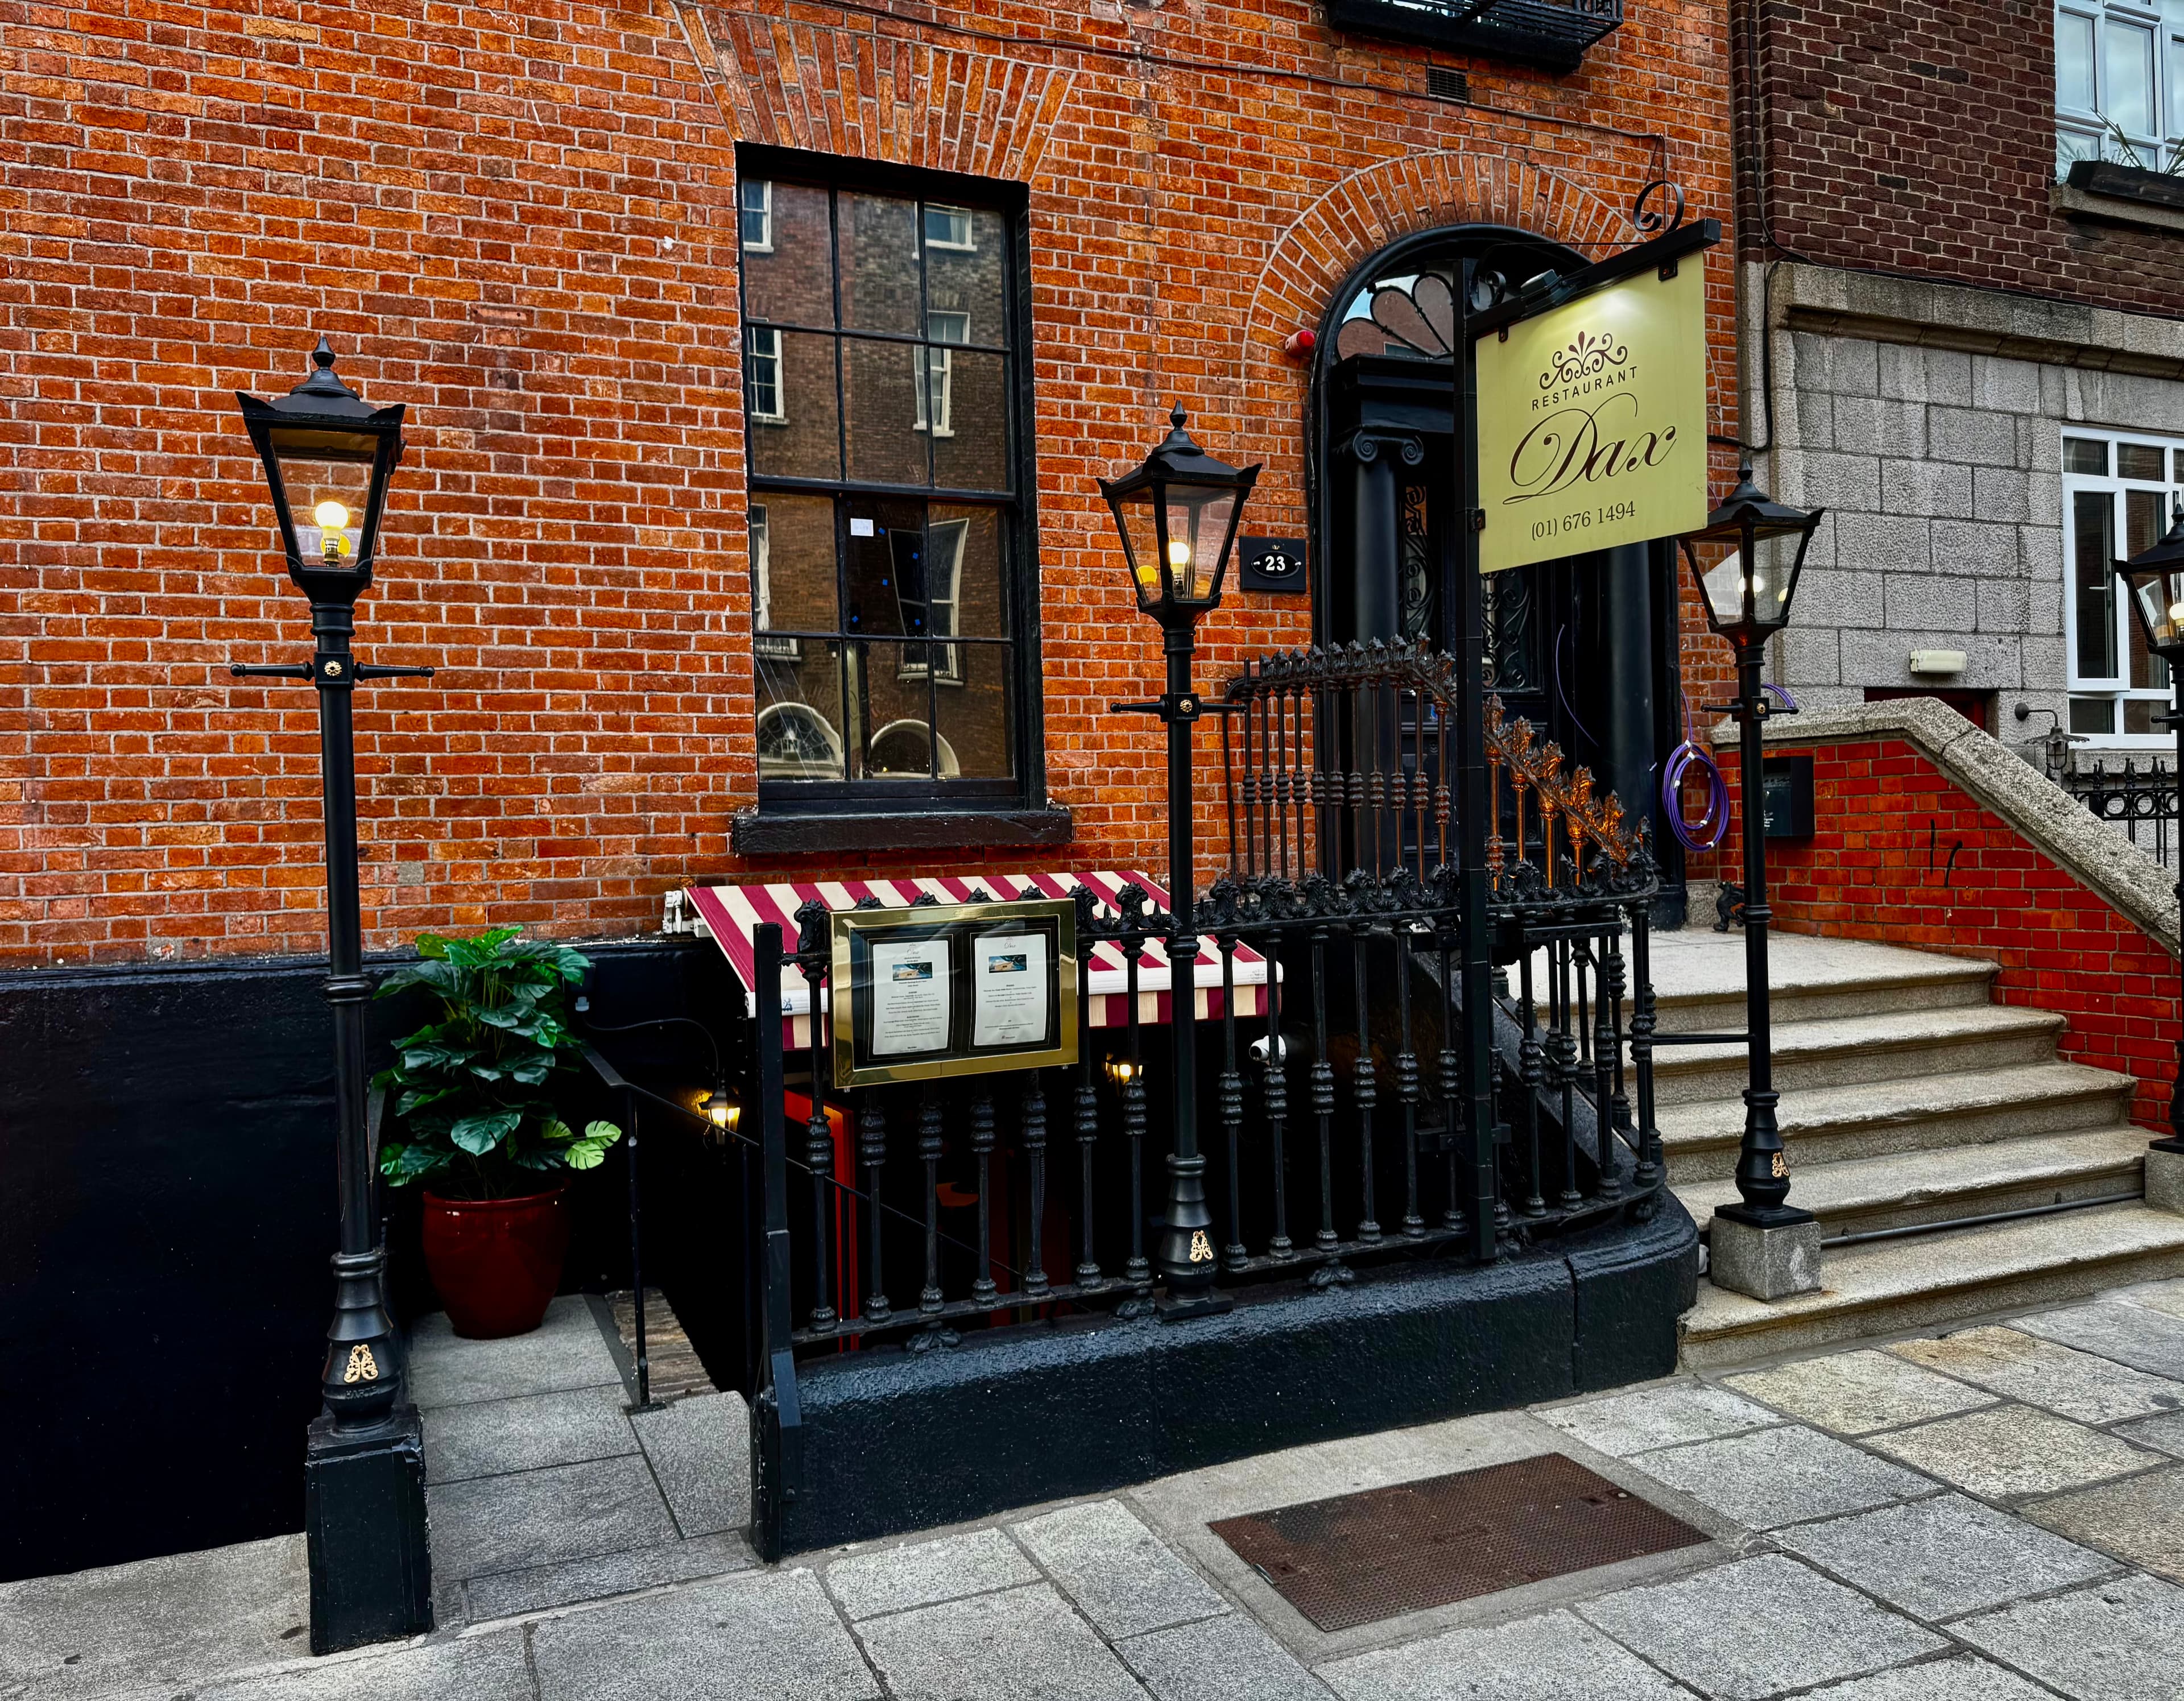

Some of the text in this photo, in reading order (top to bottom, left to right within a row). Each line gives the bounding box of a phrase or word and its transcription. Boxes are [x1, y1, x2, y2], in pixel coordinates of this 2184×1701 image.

[1532, 366, 1638, 411] RESTAURANT
[1503, 392, 1677, 504] Dax
[1532, 500, 1636, 541] (01) 676 1494
[1265, 555, 1286, 571] 23
